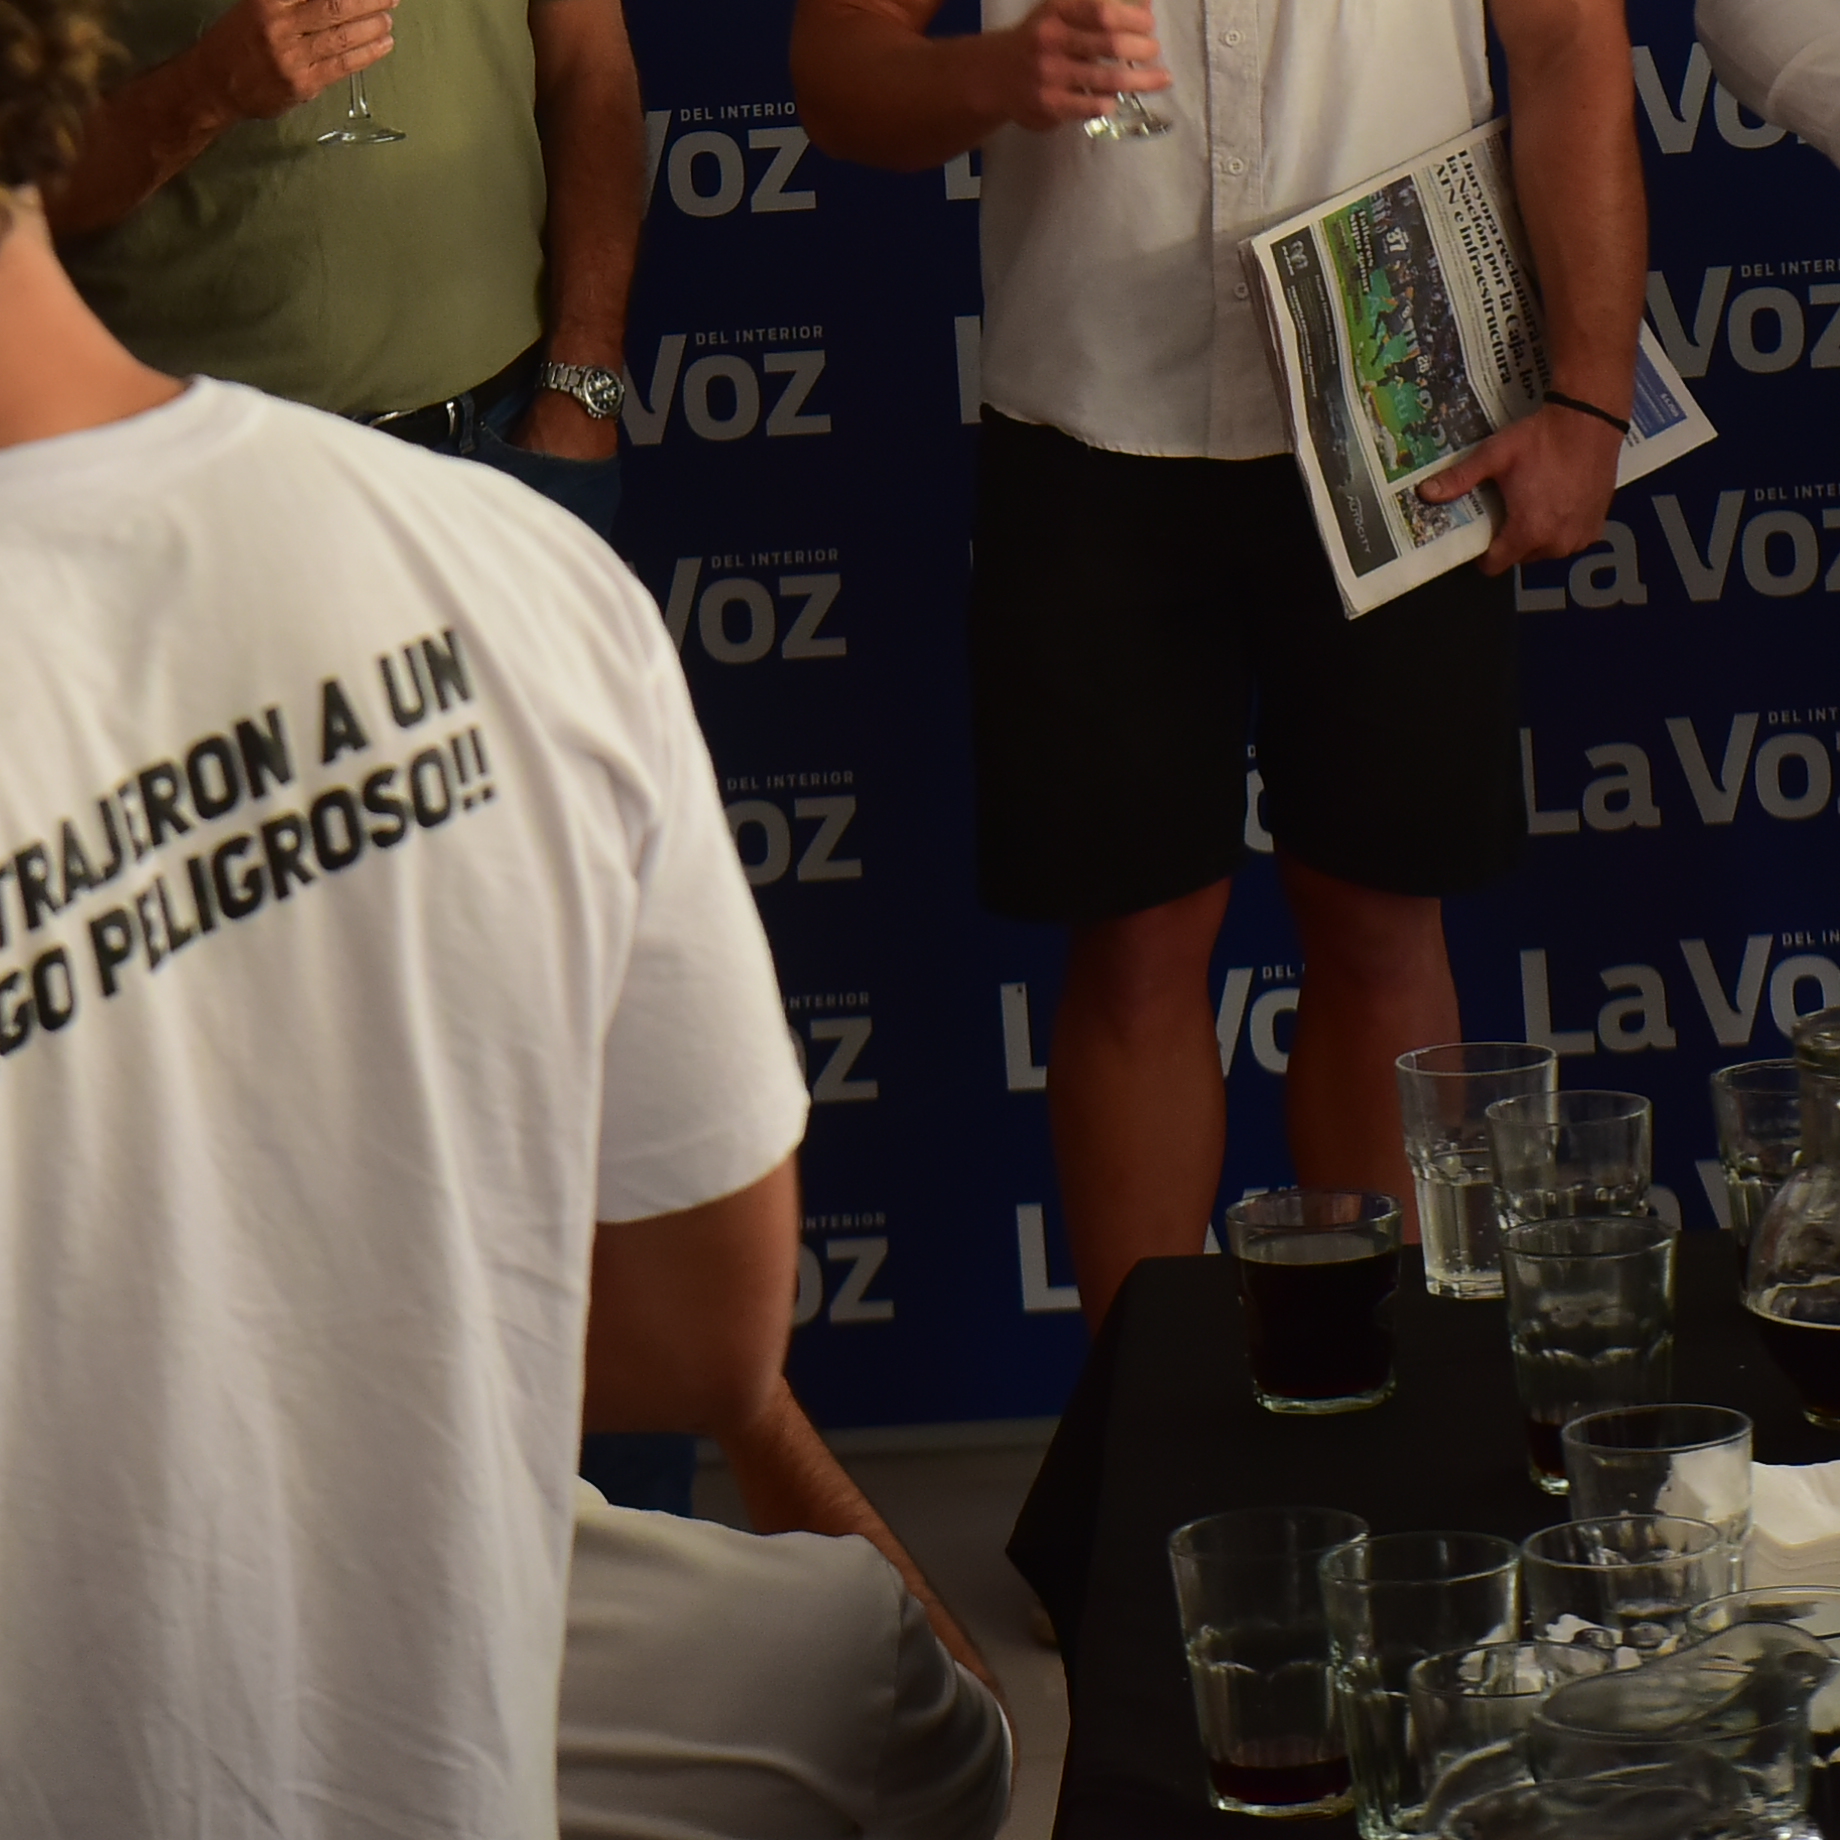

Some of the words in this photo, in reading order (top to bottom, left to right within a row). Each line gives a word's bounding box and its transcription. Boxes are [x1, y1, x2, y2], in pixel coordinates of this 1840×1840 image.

[680, 105, 716, 123] DEL
[718, 97, 798, 122] INTERIO
[1445, 154, 1463, 174] la
[1453, 175, 1494, 249] Nación
[1432, 161, 1459, 205] ATN
[1452, 209, 1464, 224] e
[1458, 224, 1515, 385] infraestructura
[1482, 251, 1507, 288] por
[1741, 260, 1777, 279] DEL
[1498, 290, 1515, 312] la
[695, 327, 731, 345] DEL
[733, 319, 825, 344] INTERIOR
[1754, 484, 1790, 503] DEL
[1345, 494, 1371, 555] AUTOCITY
[319, 676, 368, 765] A
[377, 626, 473, 730] UN
[1768, 707, 1803, 725] DEL
[725, 795, 864, 888] oz
[89, 726, 497, 999] PELIGROSO!!
[1781, 929, 1816, 947] DEL
